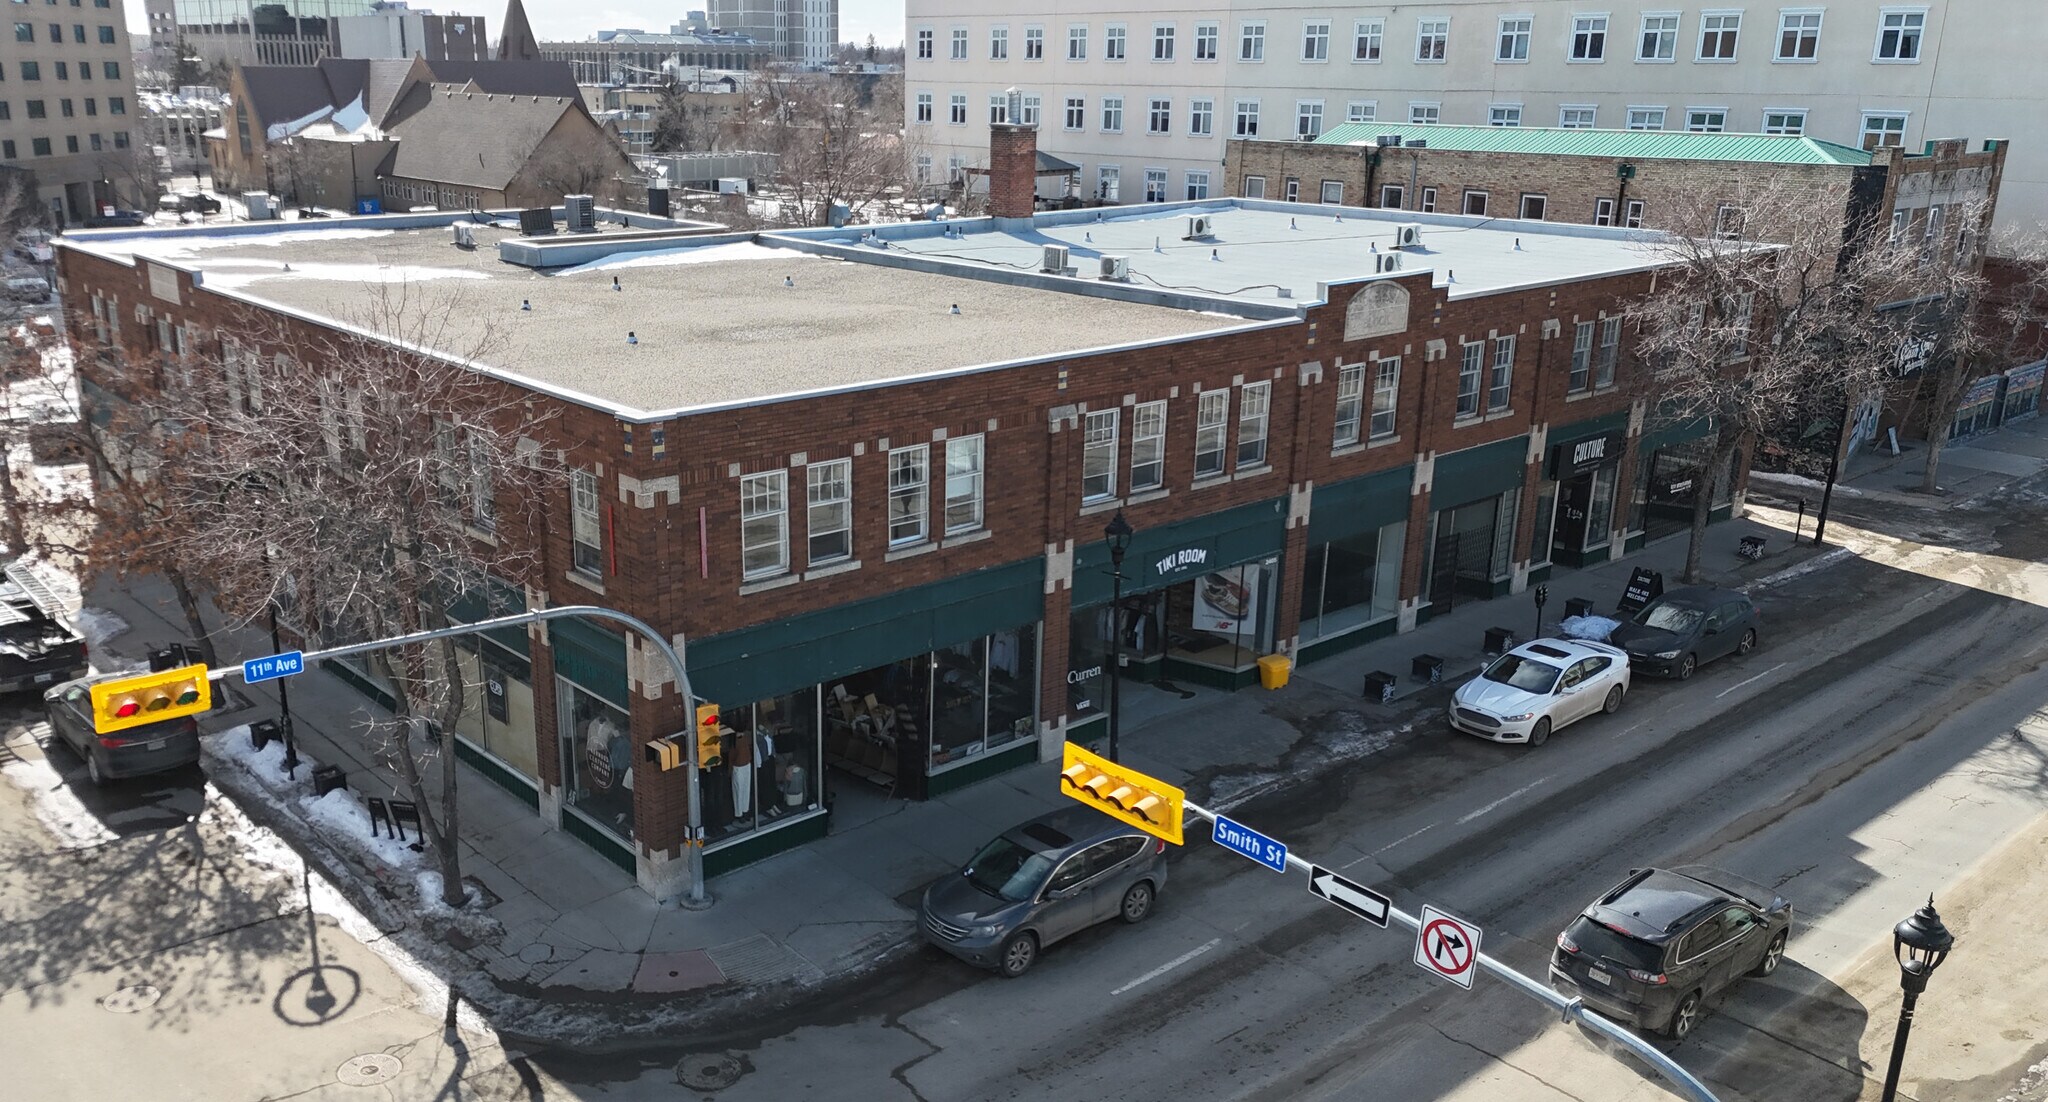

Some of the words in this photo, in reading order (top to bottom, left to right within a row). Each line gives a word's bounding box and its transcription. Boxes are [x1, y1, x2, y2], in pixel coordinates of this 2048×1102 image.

[1573, 437, 1606, 465] CULTURE
[1156, 554, 1176, 575] TIKI
[1178, 549, 1206, 564] ROOM
[250, 662, 272, 677] 11th
[275, 659, 297, 672] Ave
[1217, 822, 1260, 856] Smith
[1266, 845, 1282, 866] St
